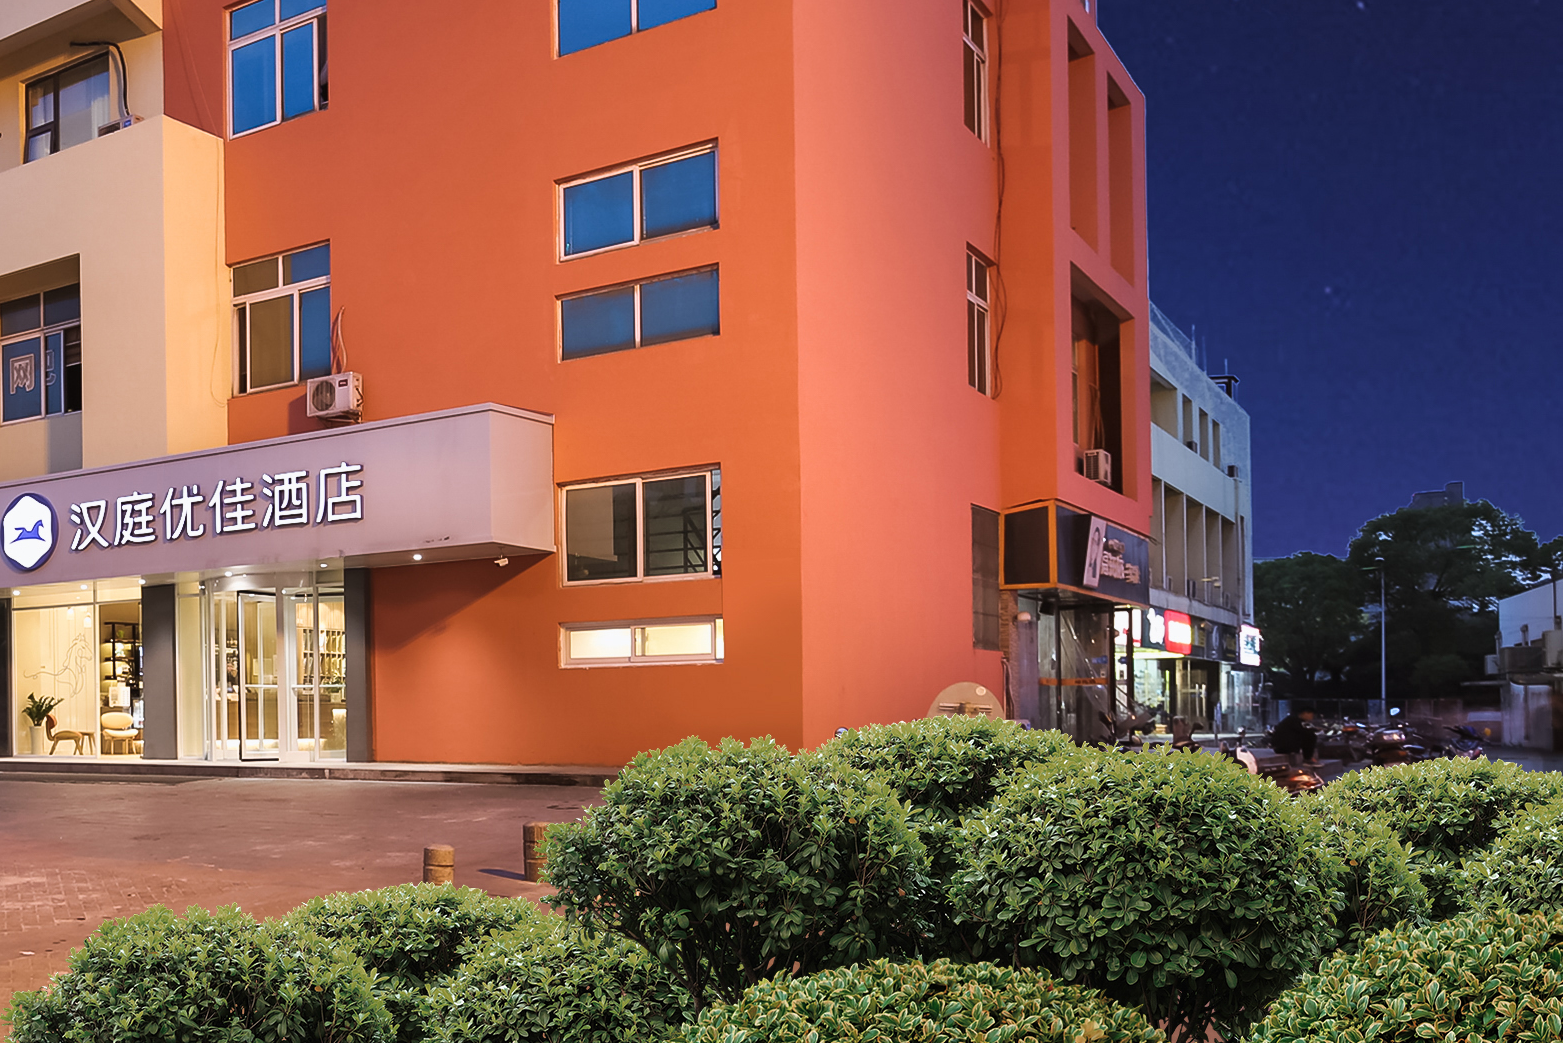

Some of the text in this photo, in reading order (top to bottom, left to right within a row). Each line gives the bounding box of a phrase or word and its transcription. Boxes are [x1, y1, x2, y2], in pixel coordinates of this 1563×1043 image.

[70, 461, 364, 551] 汉庭优佳酒店
